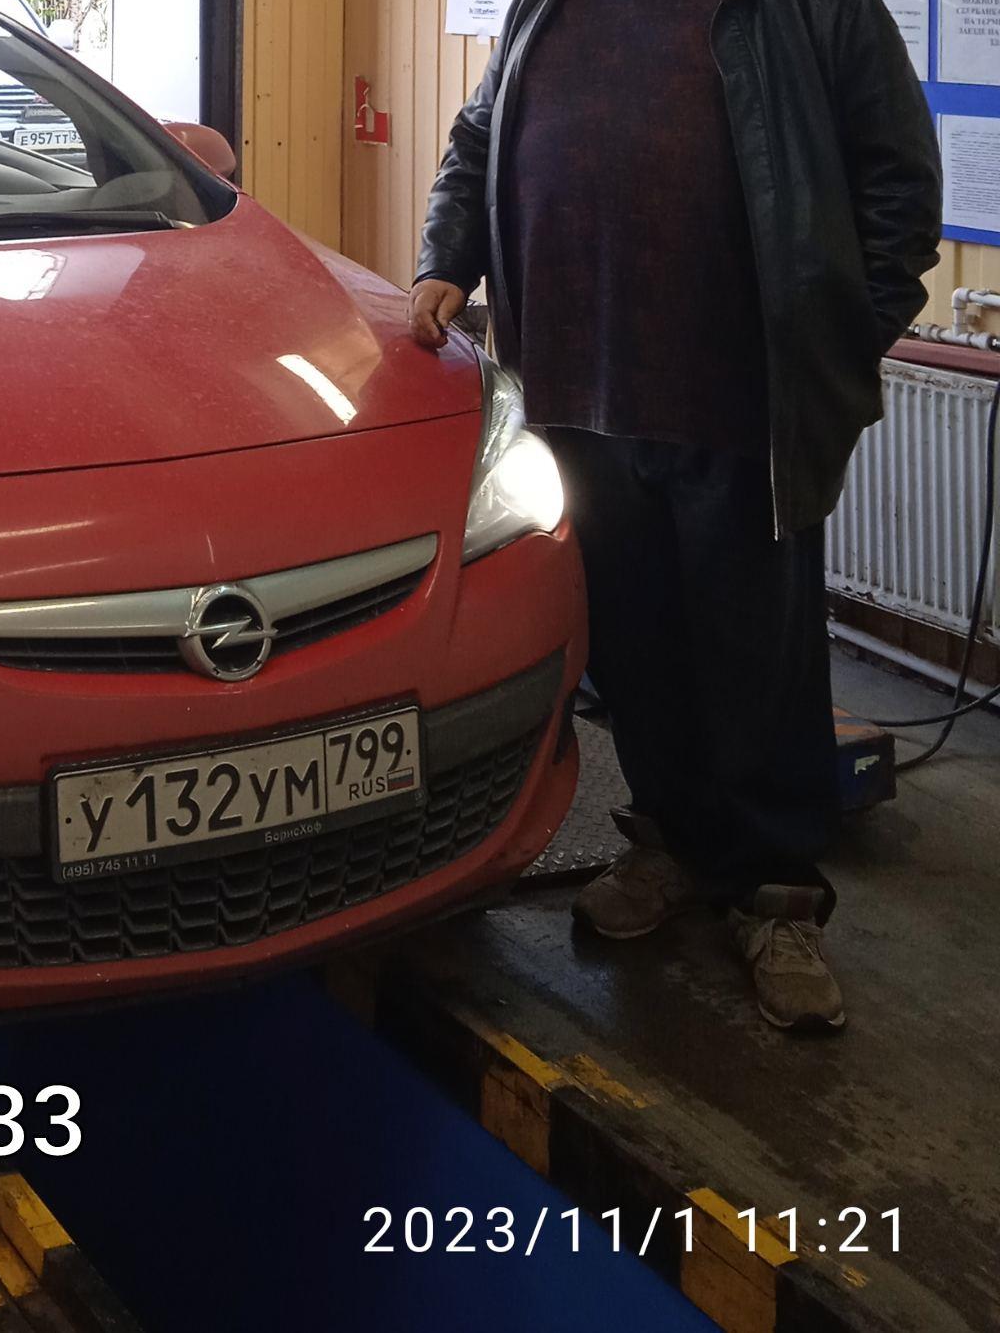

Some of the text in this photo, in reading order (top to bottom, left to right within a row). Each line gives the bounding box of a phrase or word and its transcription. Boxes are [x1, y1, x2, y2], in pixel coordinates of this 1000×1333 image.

[328, 721, 405, 786] 799
[79, 759, 321, 853] У132УМ
[348, 777, 387, 801] RUS
[61, 862, 95, 879] (495)
[97, 858, 121, 873] 745
